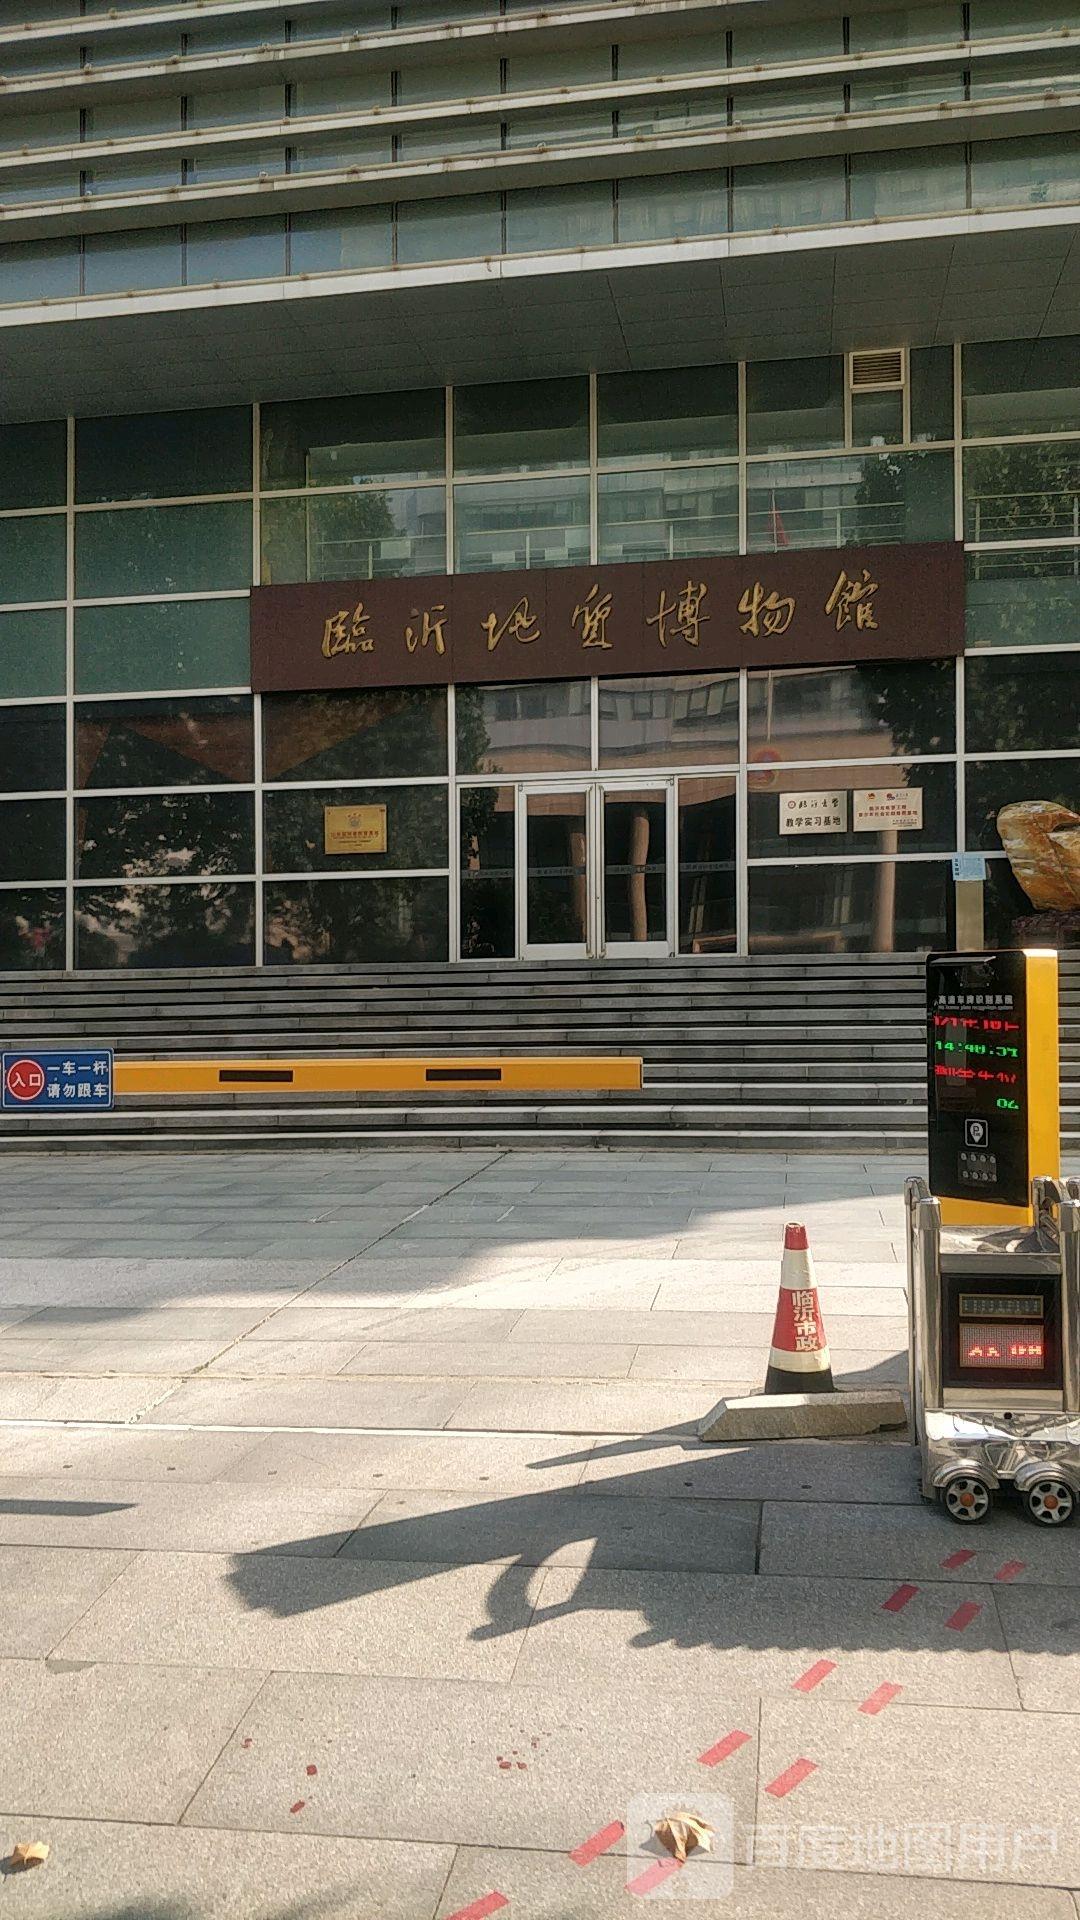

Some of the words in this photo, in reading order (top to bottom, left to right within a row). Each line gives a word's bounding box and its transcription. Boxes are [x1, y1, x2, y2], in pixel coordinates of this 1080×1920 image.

[786, 816, 842, 827] 教学实习基地
[47, 1060, 108, 1076] 一车一杆
[11, 1072, 41, 1088] 入口
[47, 1083, 108, 1098] 请勿跟车
[791, 1290, 819, 1351] 临沂市政
